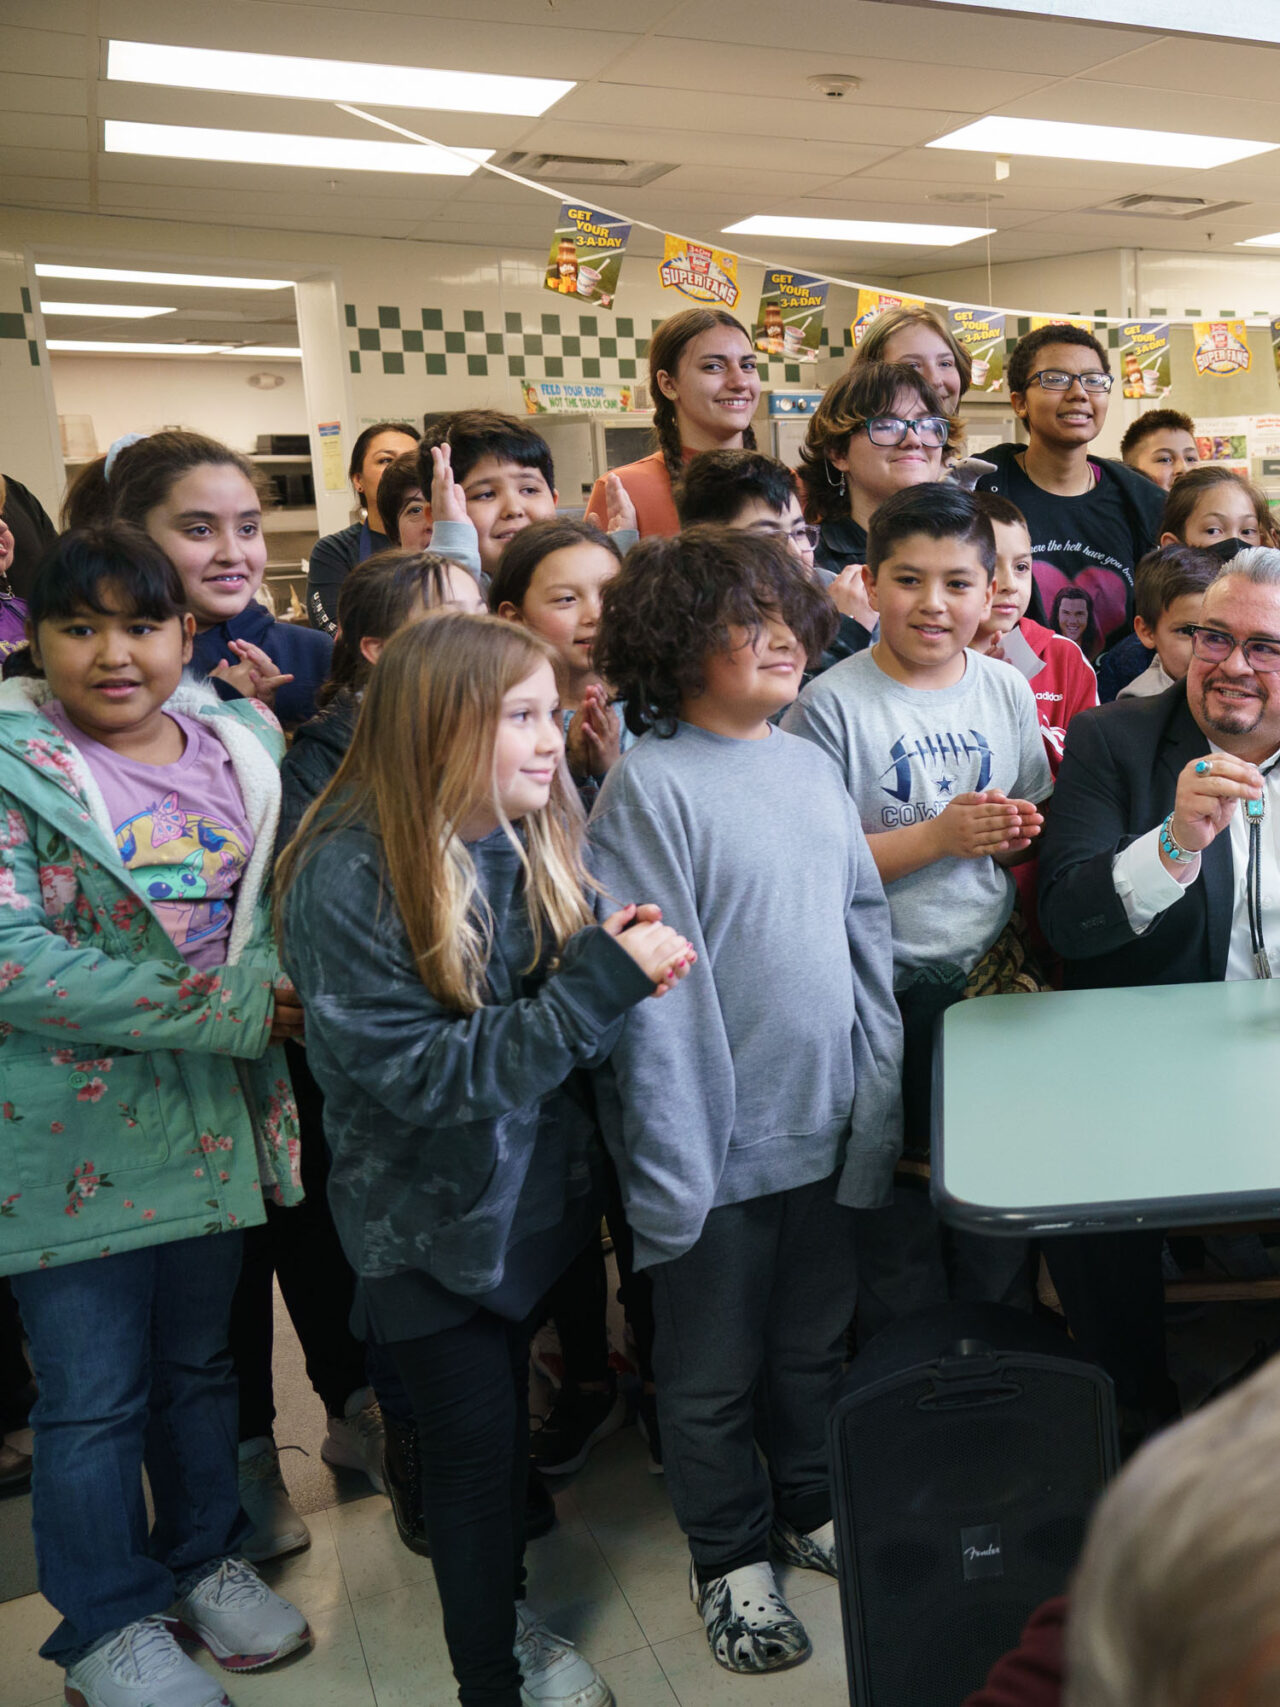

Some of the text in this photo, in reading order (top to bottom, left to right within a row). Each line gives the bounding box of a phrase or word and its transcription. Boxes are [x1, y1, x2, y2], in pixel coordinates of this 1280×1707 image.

[567, 208, 593, 221] GET
[575, 219, 610, 238] YOUR
[575, 235, 623, 248] 3-A-DAY
[771, 273, 794, 284] GET
[661, 266, 738, 307] SUPER FANS
[779, 283, 810, 298] YOUR
[780, 296, 823, 308] 3-A-DAY
[953, 311, 974, 321] GET
[962, 320, 989, 331] YOUR
[1123, 325, 1141, 336] GET
[964, 328, 1000, 344] 3-A-DAY
[1131, 333, 1156, 343] YOUR
[1135, 338, 1167, 355] 3-A-DAY
[1196, 349, 1249, 372] SUPER FANS
[540, 383, 561, 396] FEED
[563, 384, 583, 397] YOUR
[548, 397, 562, 408] NOT
[565, 397, 579, 408] THE
[579, 398, 601, 409] TRASH
[1030, 543, 1046, 553] ere
[1047, 539, 1062, 552] the
[1063, 539, 1082, 552] hell
[1082, 545, 1105, 560] have
[1099, 555, 1122, 569] you
[1035, 691, 1063, 702] adidas
[963, 1543, 1001, 1560] Fender
